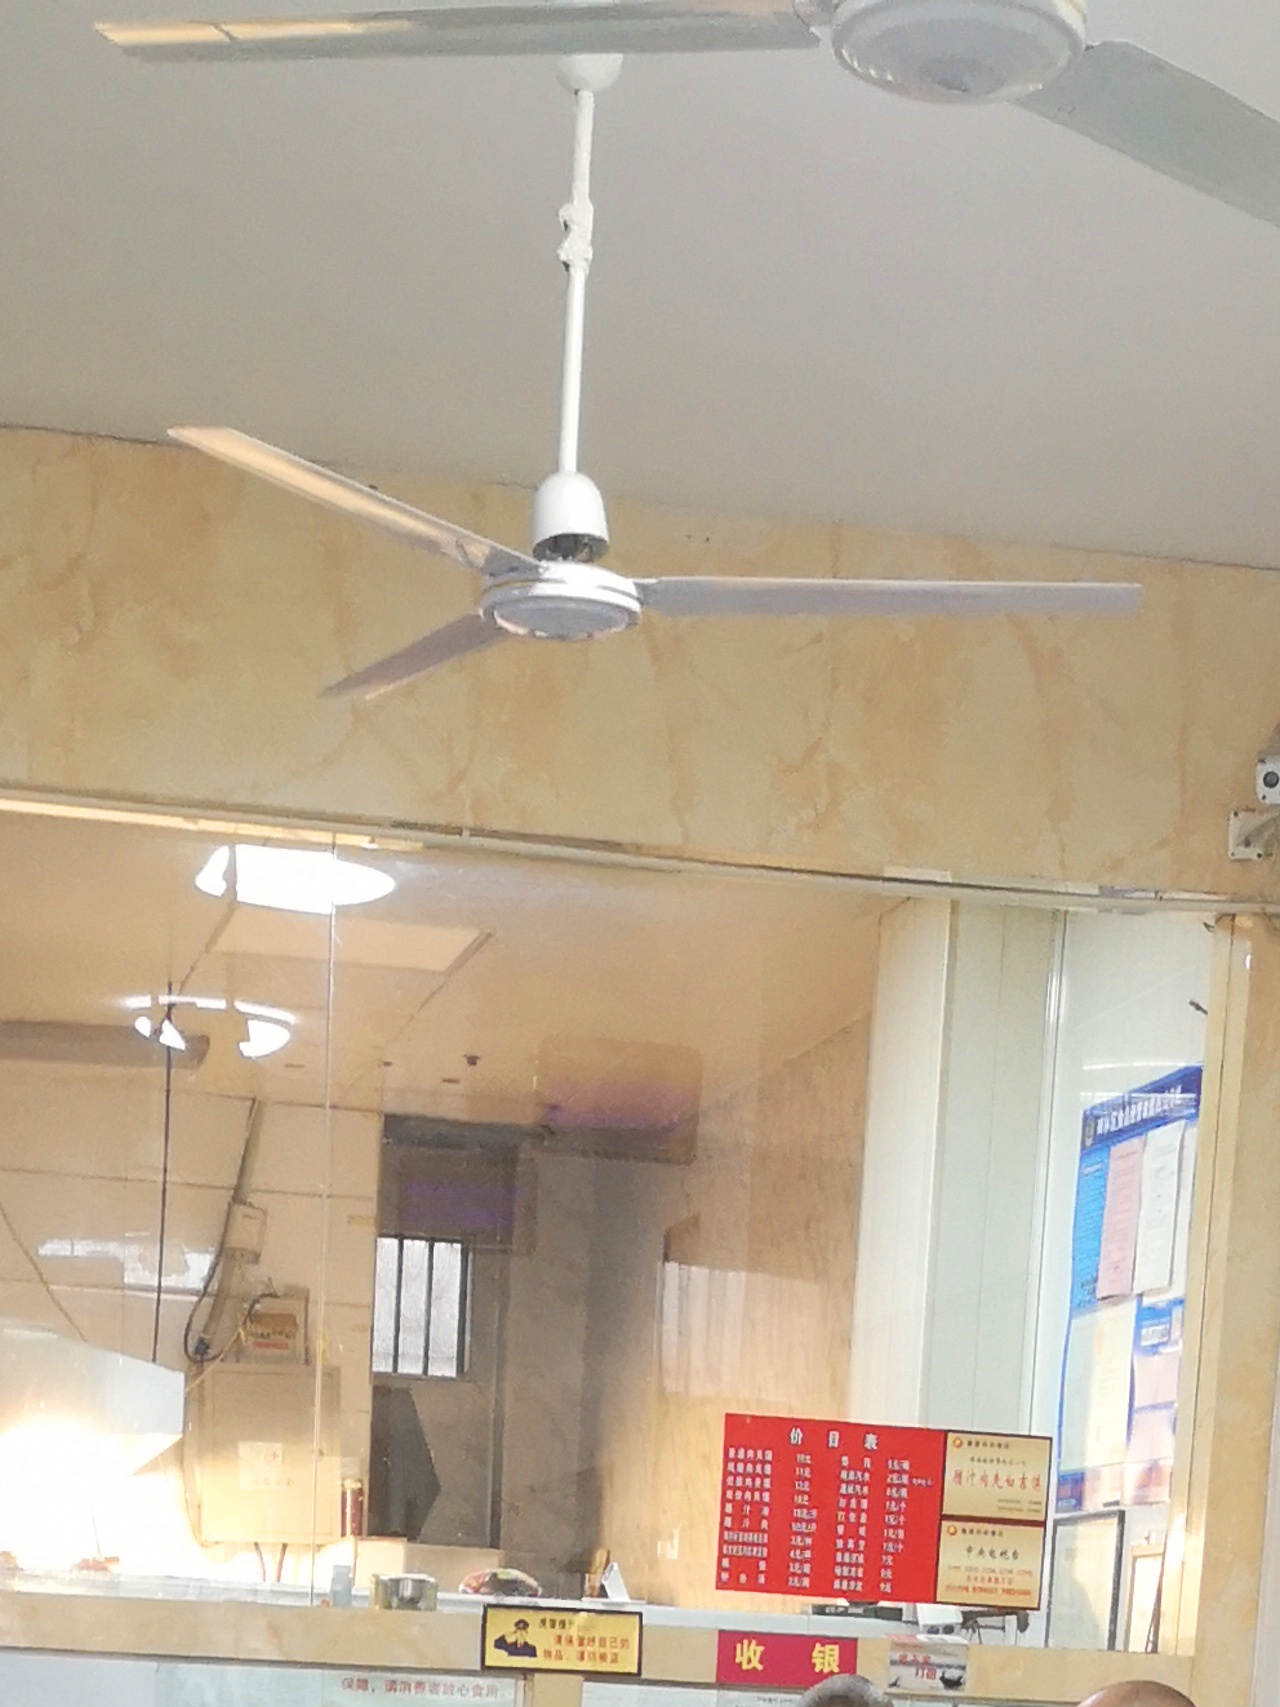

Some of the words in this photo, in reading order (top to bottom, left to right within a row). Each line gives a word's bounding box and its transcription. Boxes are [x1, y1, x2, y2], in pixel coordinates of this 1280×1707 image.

[789, 1426, 879, 1451] 价目表
[735, 1638, 841, 1674] 收银
